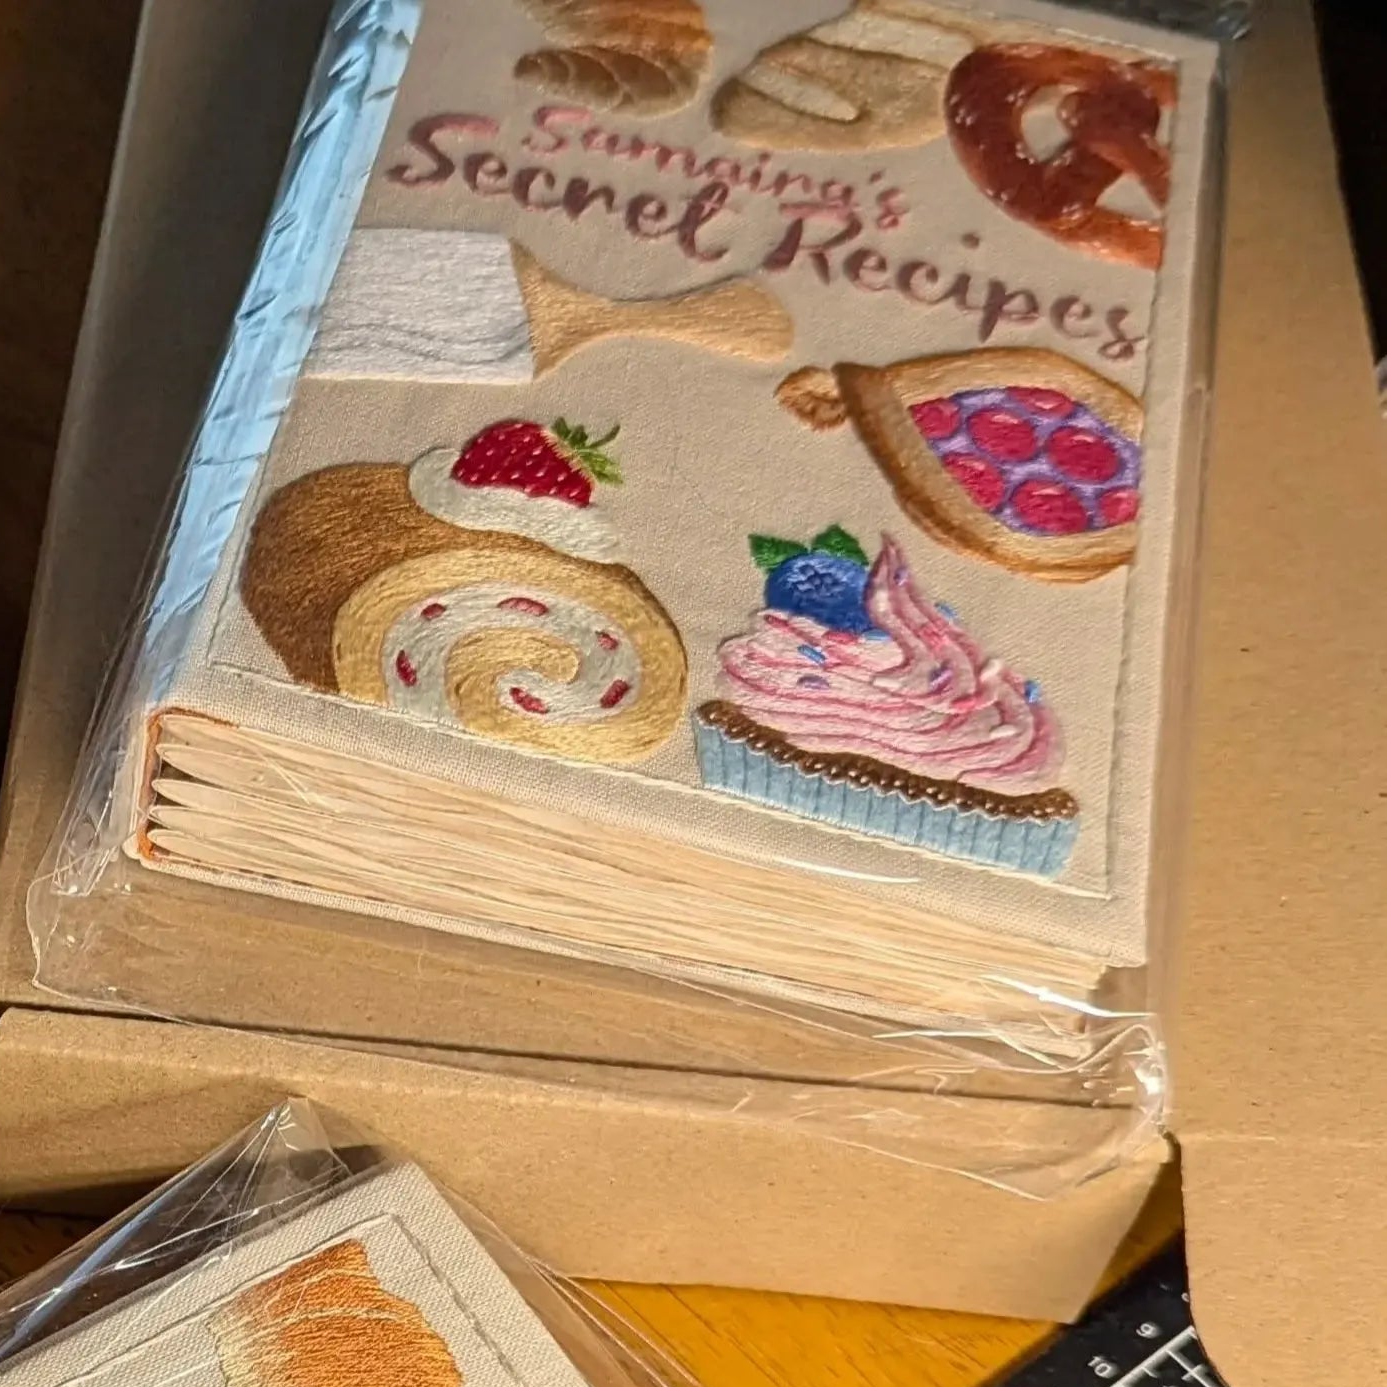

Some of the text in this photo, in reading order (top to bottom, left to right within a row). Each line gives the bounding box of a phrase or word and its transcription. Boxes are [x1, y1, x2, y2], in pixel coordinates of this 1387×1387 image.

[383, 112, 1146, 360] Secret Recipes
[1136, 1321, 1160, 1339] 9
[1088, 1355, 1117, 1378] 10
